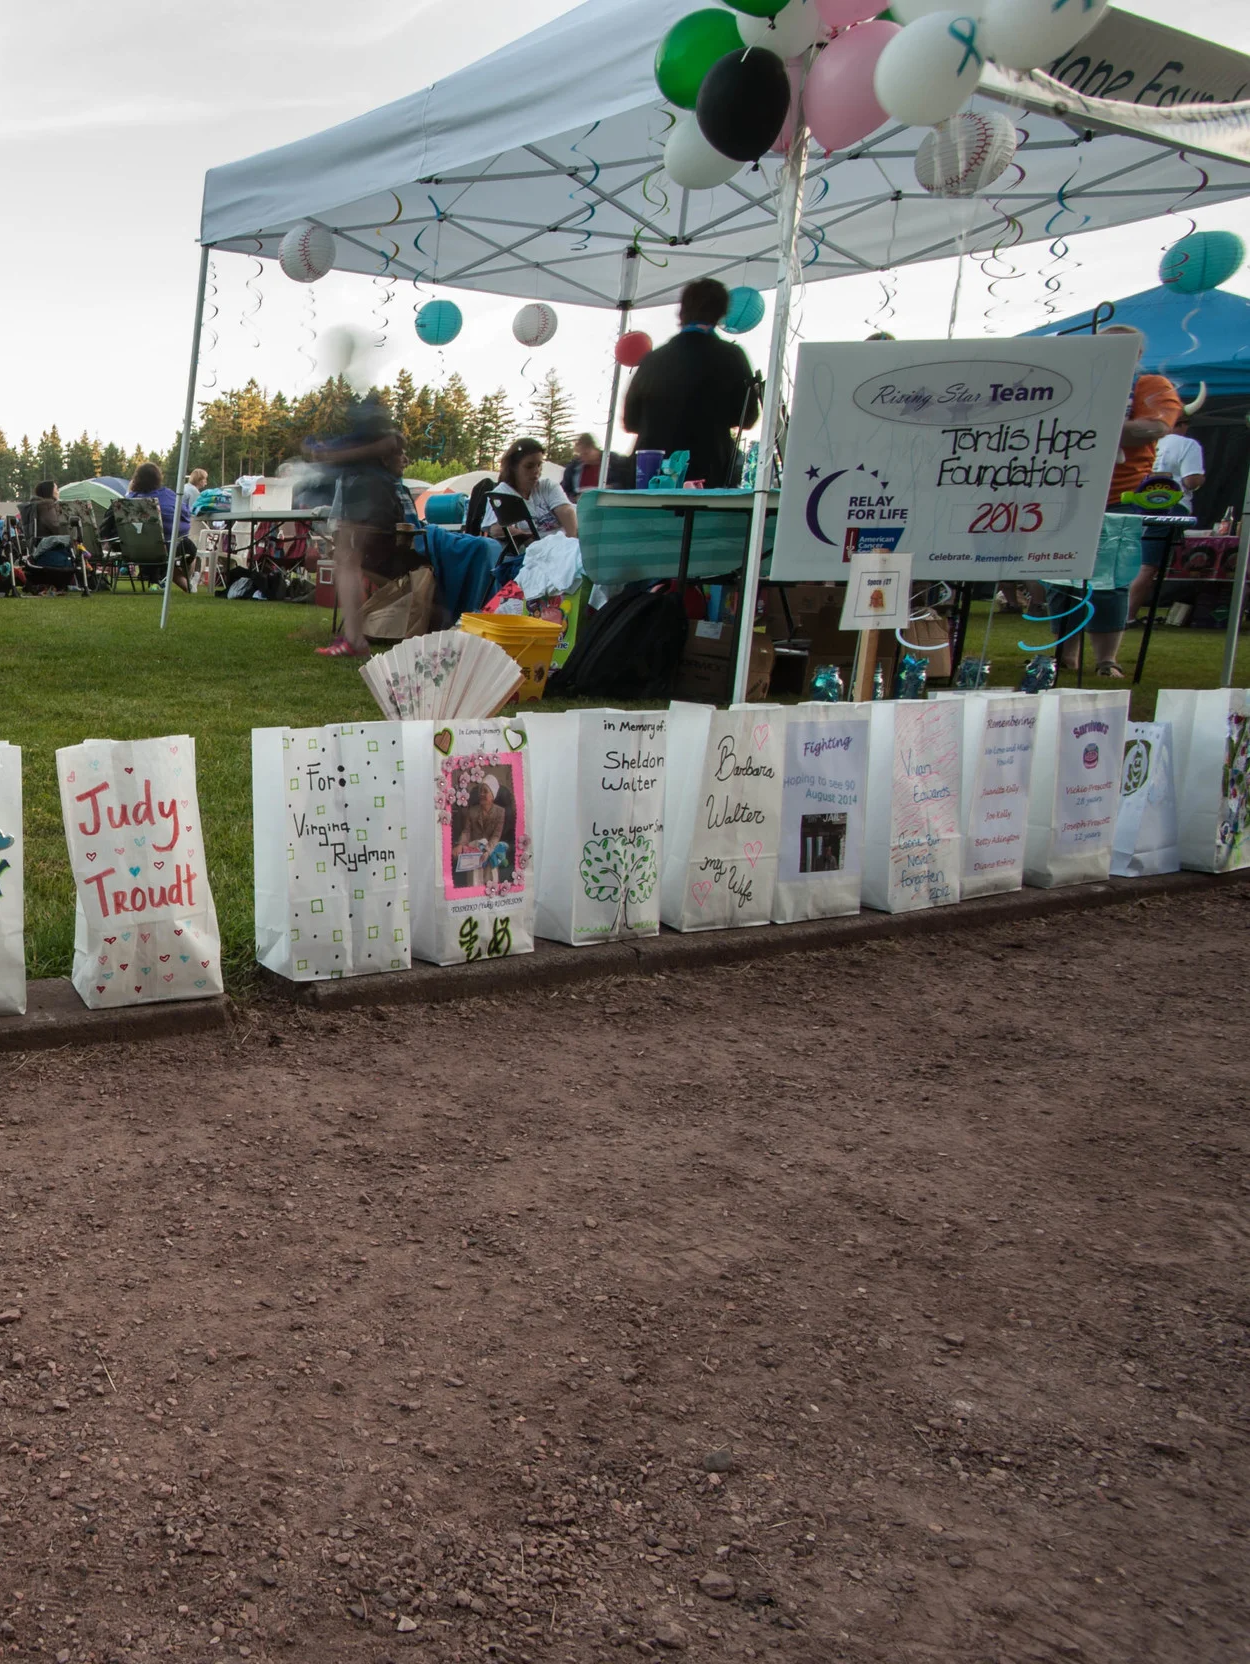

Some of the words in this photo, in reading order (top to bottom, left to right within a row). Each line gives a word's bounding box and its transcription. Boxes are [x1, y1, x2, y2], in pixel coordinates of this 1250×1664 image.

[870, 384, 932, 412] Rising
[937, 382, 982, 404] Star
[989, 383, 1054, 402] Team
[941, 424, 1030, 456] Tordis
[1035, 417, 1097, 460] Hope
[936, 455, 1084, 492] Foundation
[848, 495, 895, 508] RELAY
[846, 508, 876, 520] FOR
[879, 508, 909, 520] LIFE
[967, 501, 1044, 534] 2013
[858, 535, 895, 543] American
[928, 552, 973, 562] Celebrate.
[974, 553, 1024, 563] Remember.
[1027, 552, 1050, 563] Fight
[619, 721, 656, 740] Memory
[803, 735, 854, 757] Fighting
[603, 750, 665, 769] Sheldon
[715, 734, 775, 782] Barbara
[601, 775, 657, 792] Walter
[783, 774, 815, 789] Hoping
[817, 775, 827, 787] to
[844, 779, 856, 791] 90
[805, 788, 836, 804] August
[837, 794, 858, 805] 2014
[76, 779, 180, 853] Judy
[705, 794, 766, 830] Walter
[592, 822, 624, 837] Love
[629, 823, 654, 844] your
[330, 843, 396, 872] Rydman
[699, 855, 727, 884] my
[727, 865, 754, 909] Wife
